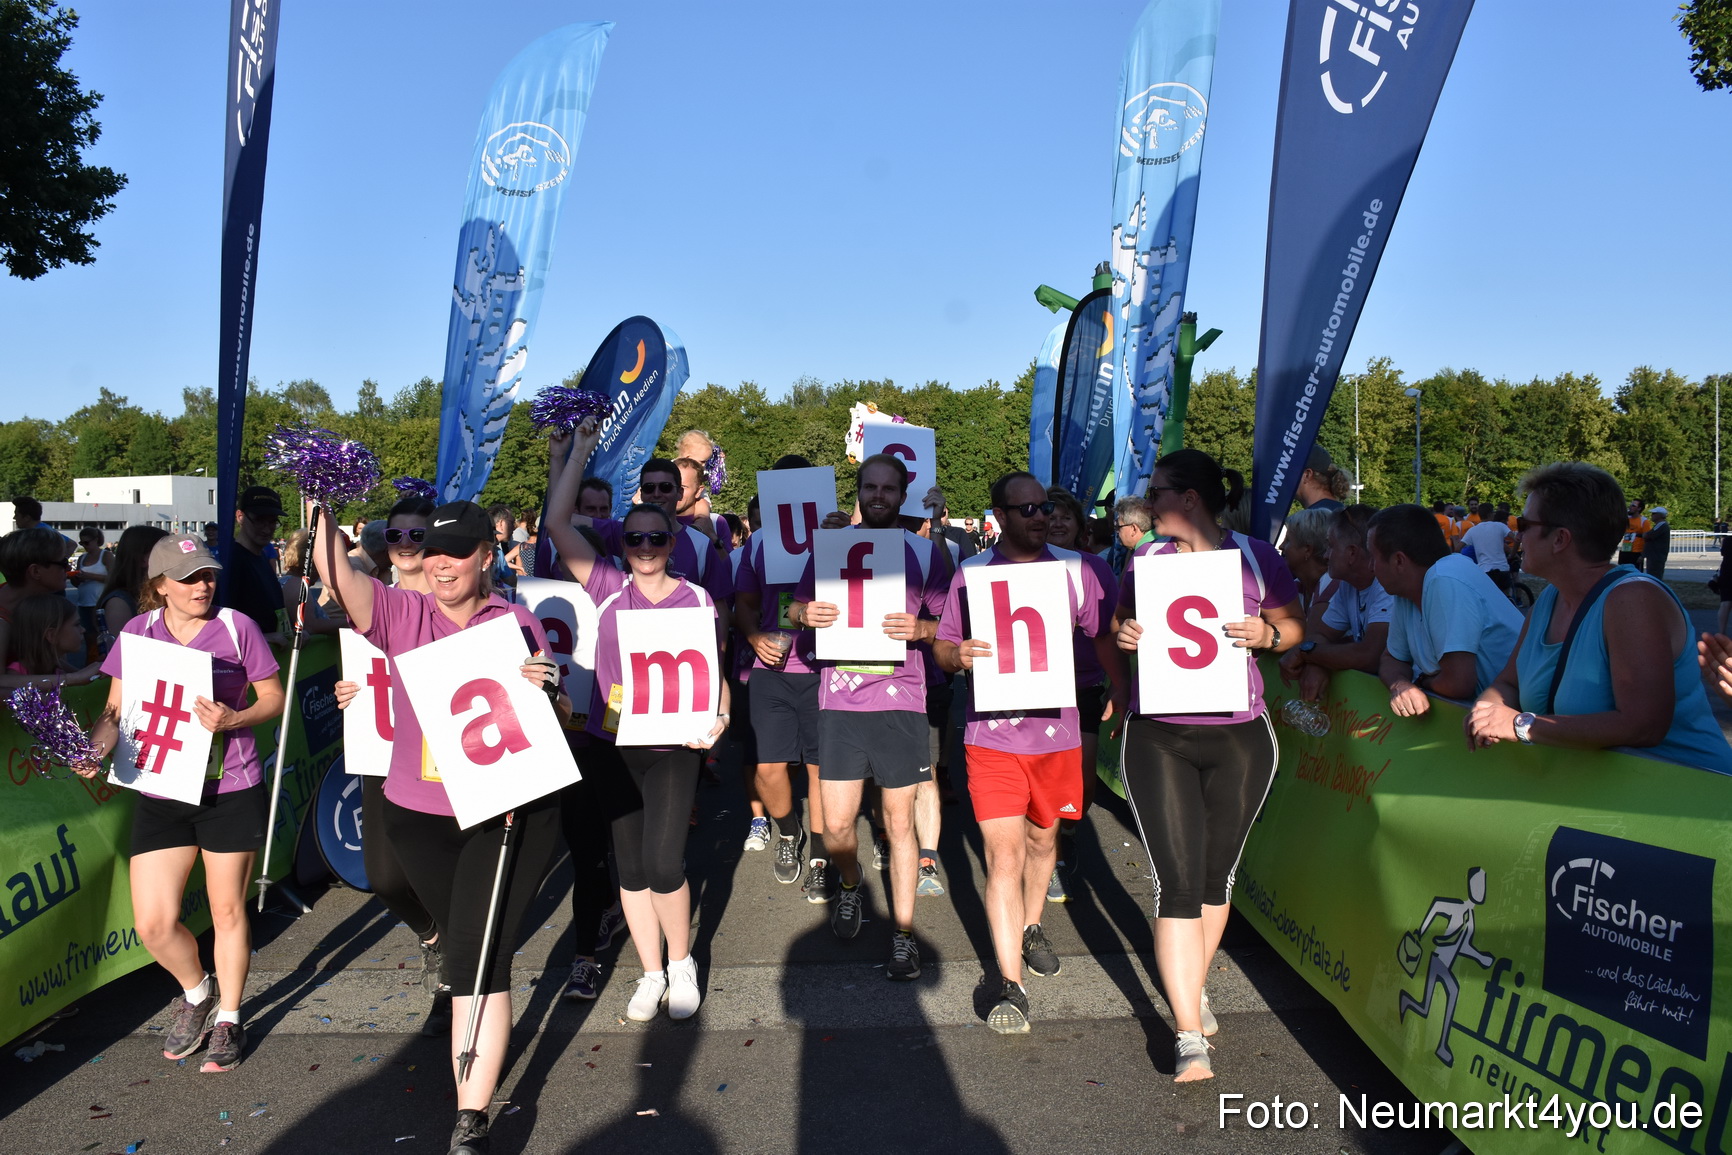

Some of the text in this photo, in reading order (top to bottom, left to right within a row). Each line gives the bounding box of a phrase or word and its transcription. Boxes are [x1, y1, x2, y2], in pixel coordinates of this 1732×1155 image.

[1265, 198, 1383, 505] www.fischer-automobile.de
[602, 369, 659, 453] Druck und Medien
[777, 502, 818, 556] u
[840, 541, 874, 629] f
[990, 580, 1049, 674] h
[366, 657, 395, 742] t
[450, 677, 532, 765] a
[630, 649, 710, 714] m
[133, 679, 192, 774] #
[0, 824, 80, 932] auf
[1572, 884, 1683, 943] Fischer
[1581, 922, 1673, 962] AUTOMOBILE
[1622, 966, 1645, 988] das
[1624, 990, 1694, 1025] fährt mit!
